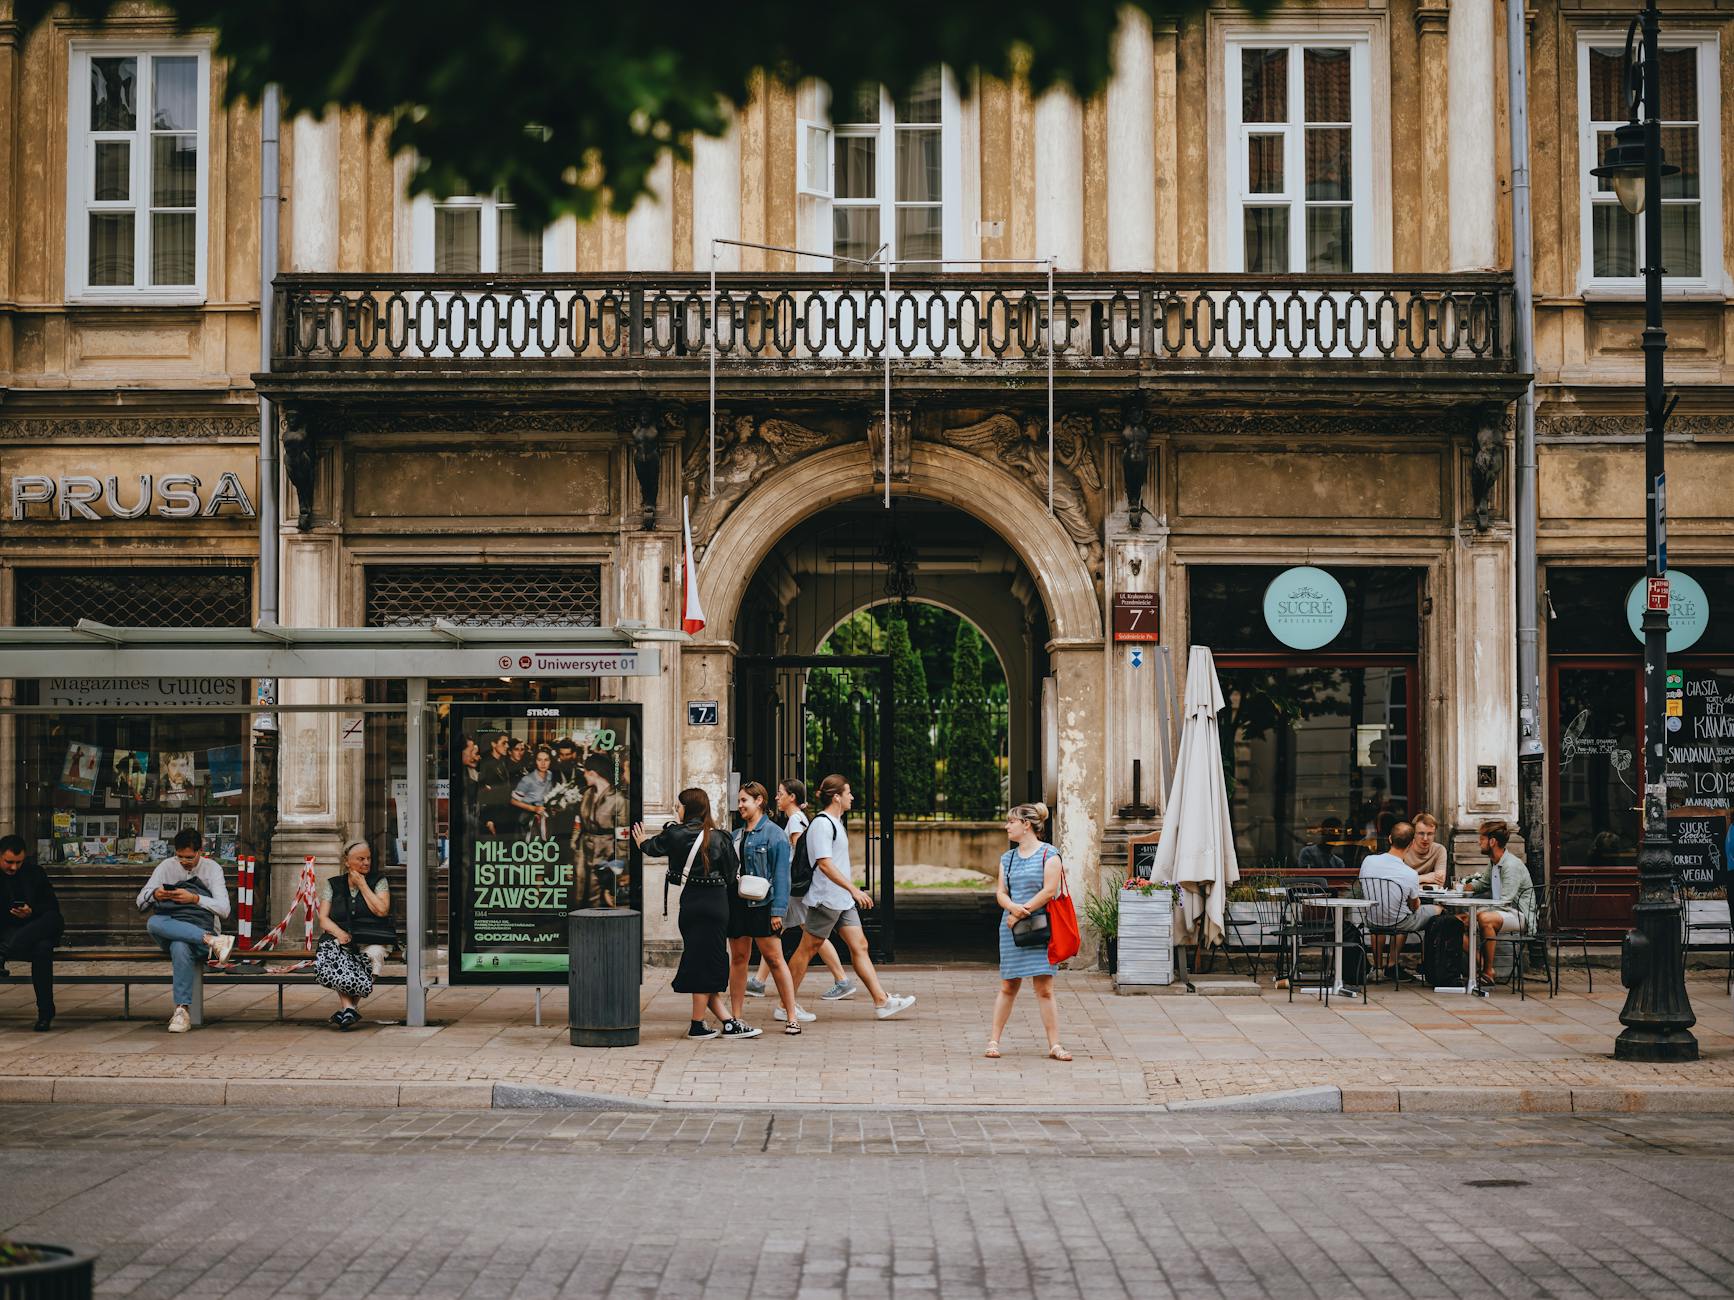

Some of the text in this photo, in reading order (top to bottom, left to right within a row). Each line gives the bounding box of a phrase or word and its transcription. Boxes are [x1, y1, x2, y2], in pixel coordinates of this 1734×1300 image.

[12, 472, 257, 520] PRUSA
[1278, 598, 1333, 614] SUCRÉ
[1129, 609, 1143, 631] 7
[537, 658, 636, 672] Uniwersytet 01
[50, 678, 150, 693] Magazines
[1686, 680, 1719, 697] CIASTA
[526, 708, 560, 716] STRÖER
[698, 707, 708, 723] 7
[1695, 772, 1730, 794] LODY
[475, 836, 560, 862] MIŁOŚĆ
[1673, 855, 1703, 866] ORBETY
[474, 864, 574, 886] ISTNIEJE
[1683, 869, 1714, 881] VEGAN
[474, 888, 568, 909] ZAWSZE
[474, 933, 531, 942] GODZINA
